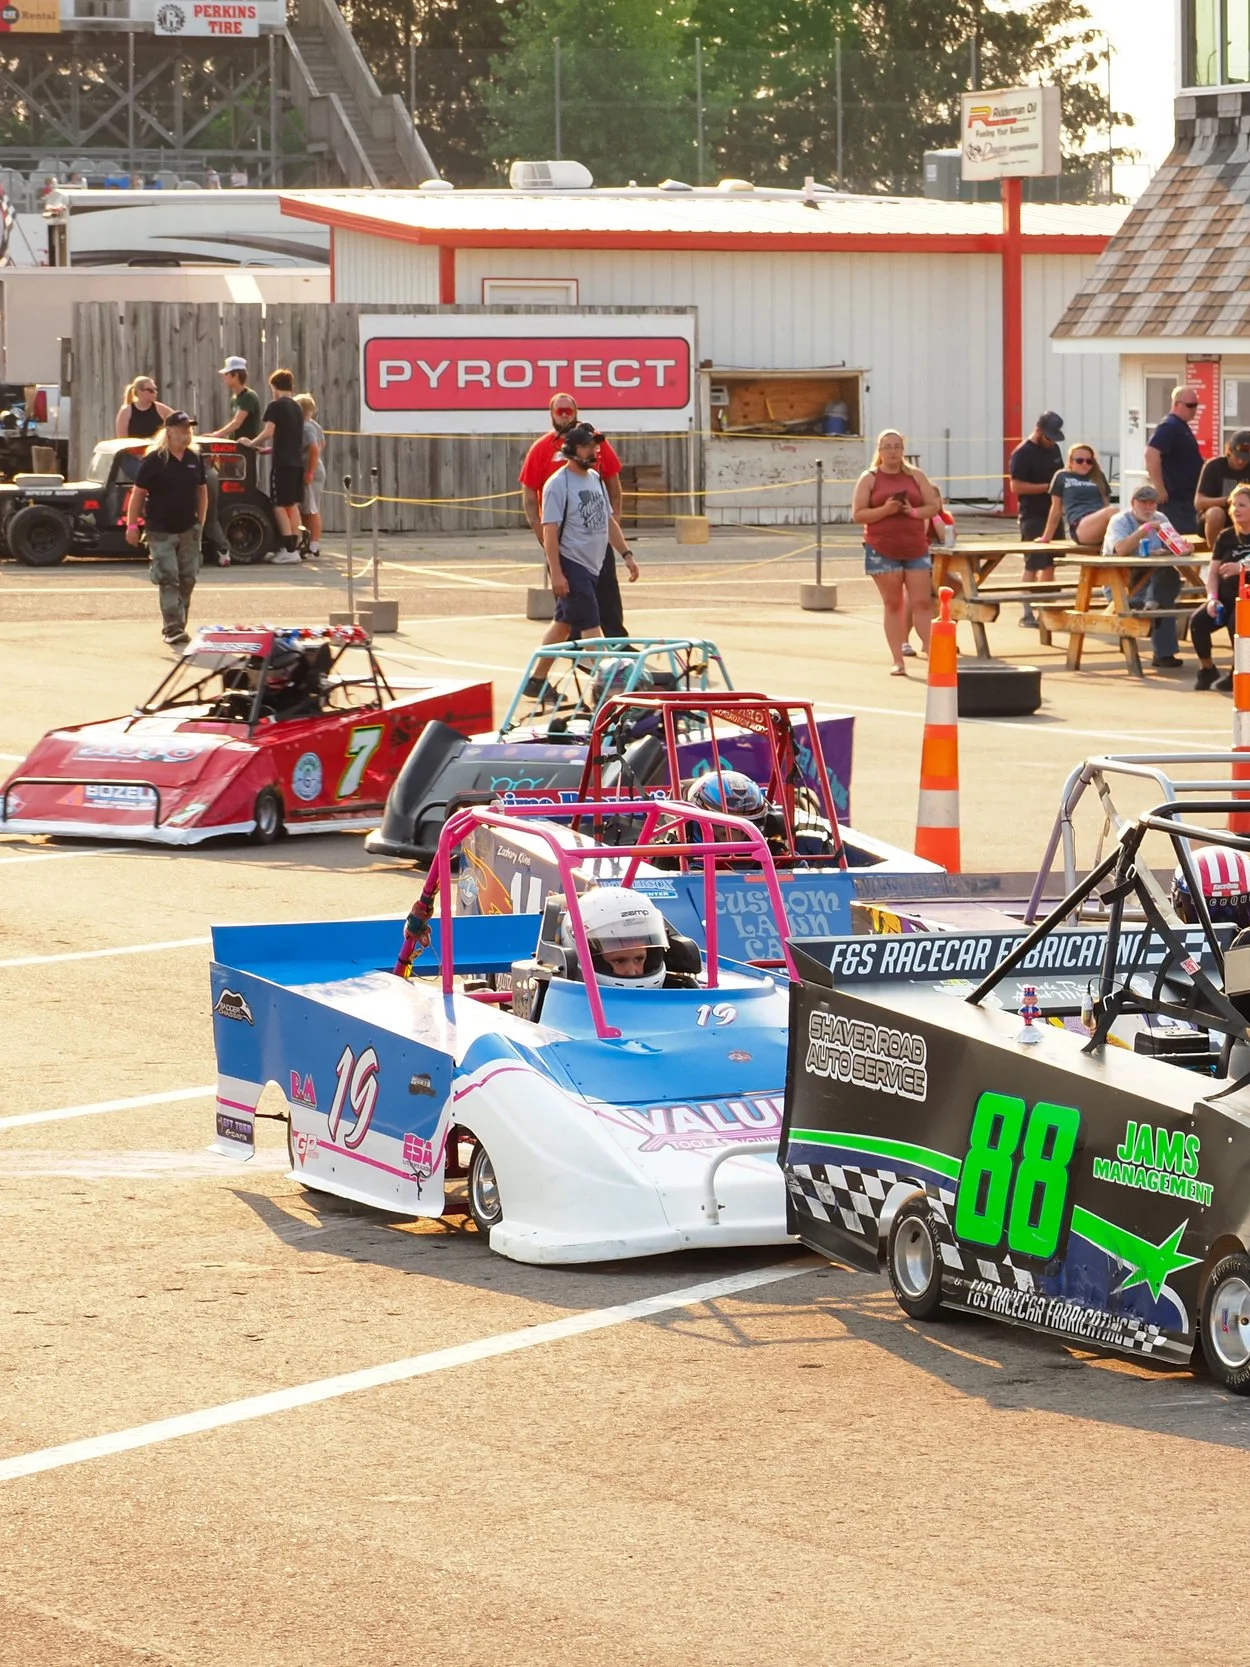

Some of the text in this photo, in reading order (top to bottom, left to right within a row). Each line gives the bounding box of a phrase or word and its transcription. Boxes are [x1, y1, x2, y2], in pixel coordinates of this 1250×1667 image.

[21, 10, 56, 20] Rental
[193, 4, 256, 19] PERKINS
[208, 21, 242, 34] TIRE
[378, 358, 676, 390] PYROTECT
[335, 724, 385, 801] 7
[621, 908, 649, 918] zamp
[744, 937, 785, 960] CA
[831, 943, 877, 976] F&S
[880, 938, 993, 974] RACECAR
[996, 932, 1146, 971] FBRICATNG
[696, 1003, 738, 1027] 19
[809, 1010, 926, 1065] SHAVER ROAD
[806, 1042, 927, 1102] AUTO SERVICE
[327, 1043, 380, 1150] 19
[618, 1098, 784, 1138] VALU
[1117, 1120, 1200, 1178] JAMS
[954, 1090, 1082, 1259] 88
[1093, 1157, 1214, 1206] MANAGEMENT
[990, 1286, 1046, 1324] RACECAR
[1045, 1298, 1128, 1344] FABRICATING
